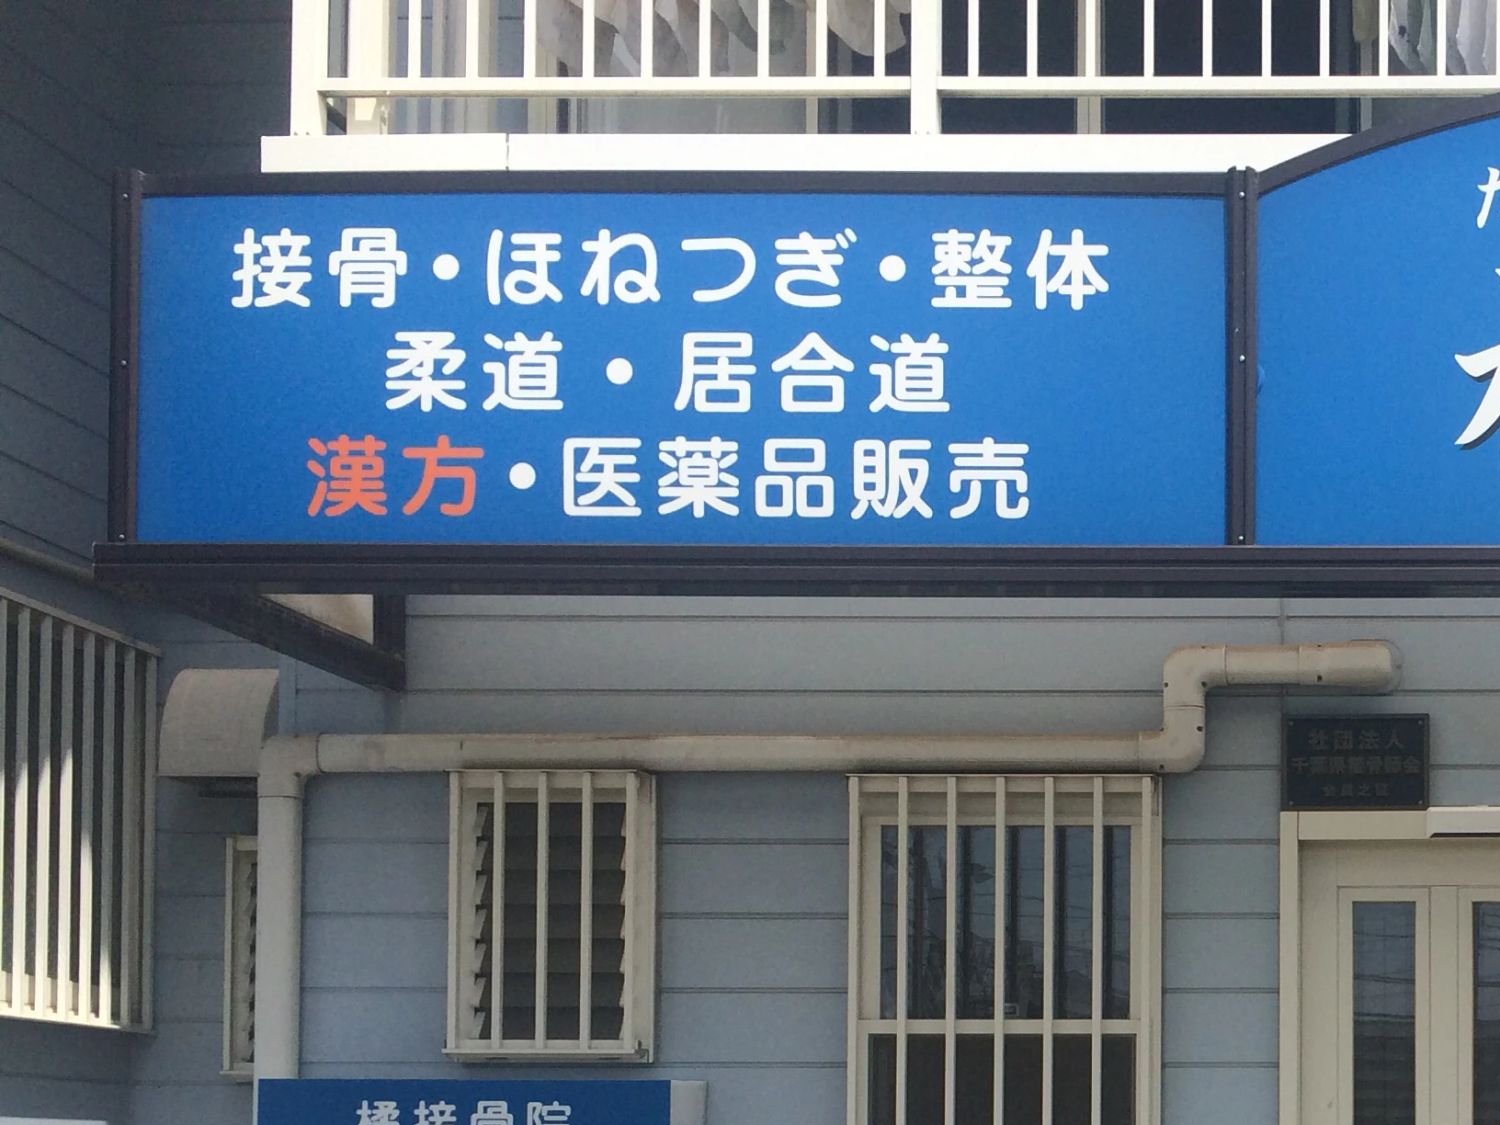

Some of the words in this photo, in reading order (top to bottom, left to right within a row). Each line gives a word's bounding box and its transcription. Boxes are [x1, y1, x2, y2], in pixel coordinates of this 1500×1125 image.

[385, 331, 951, 413] 柔道・居合道
